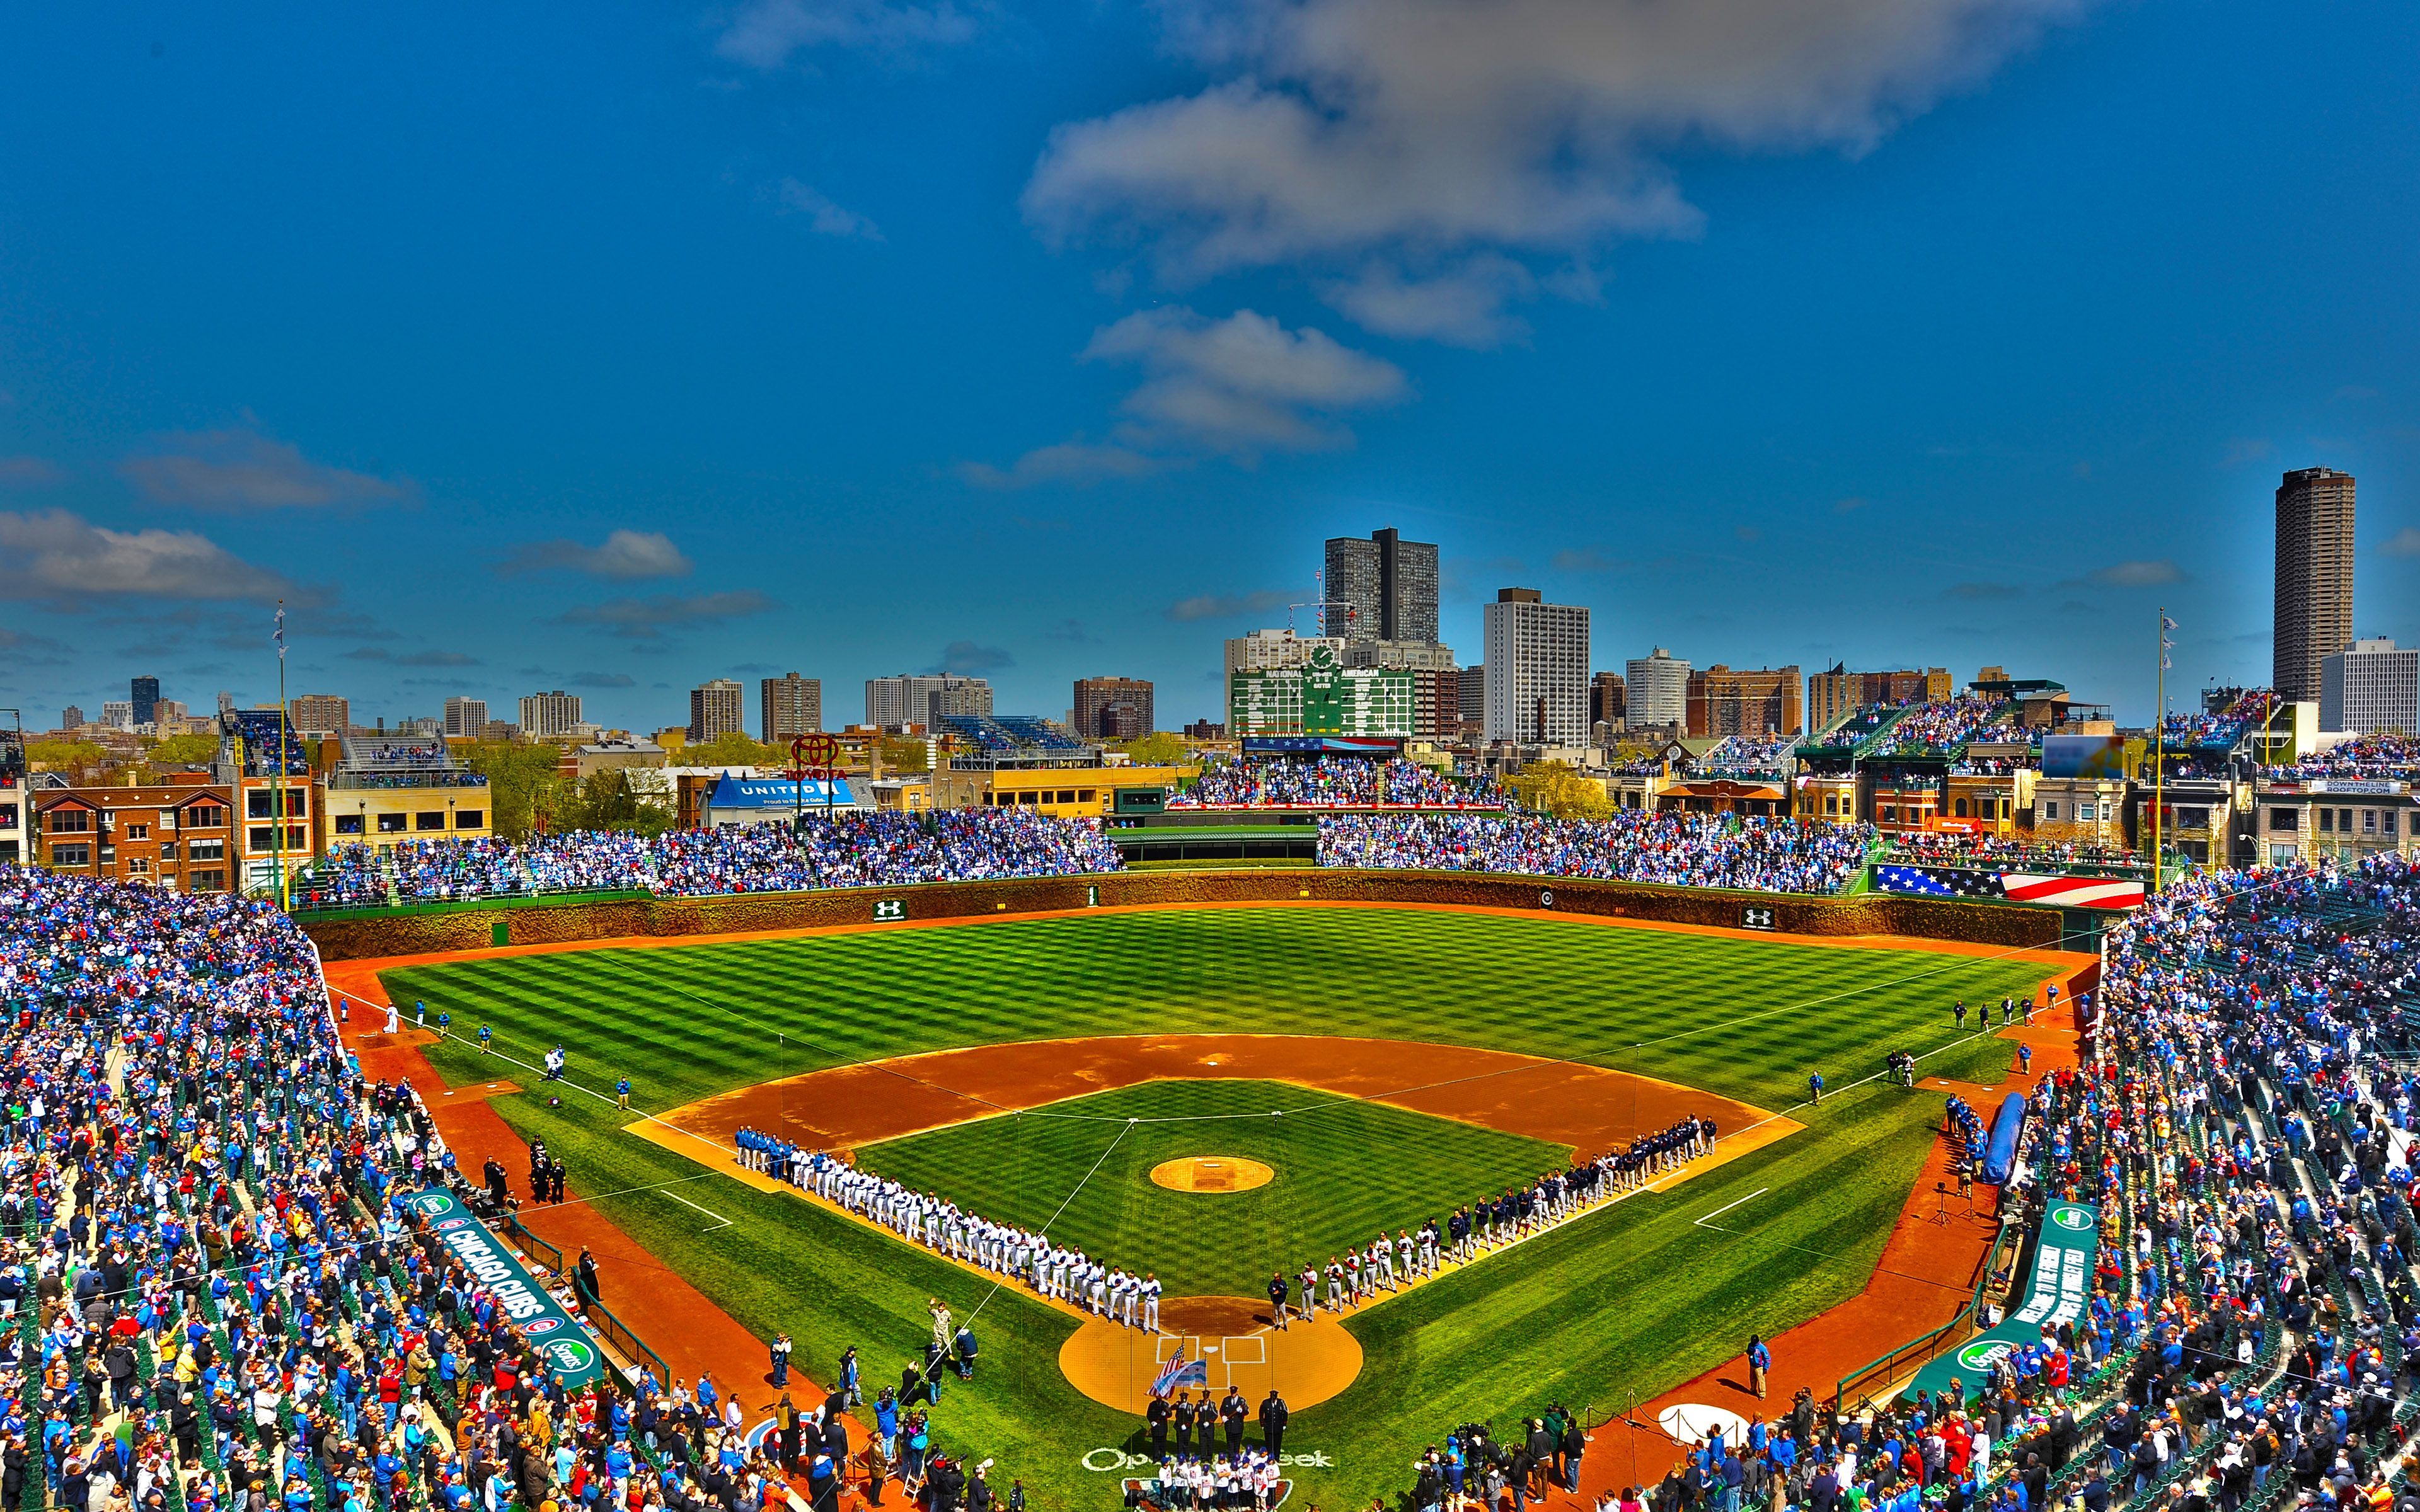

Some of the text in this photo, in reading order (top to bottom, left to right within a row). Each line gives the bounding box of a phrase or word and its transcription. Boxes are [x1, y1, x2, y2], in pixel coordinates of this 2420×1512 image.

[1265, 670, 1303, 678] NATIONAL
[1341, 669, 1380, 677] AMERICAN
[784, 769, 848, 782] TOYOTA
[740, 785, 815, 795] UNITED
[2064, 1248, 2085, 1267] FIELD
[446, 1230, 545, 1319] CHICAGO CUBS
[2014, 1292, 2056, 1324] WELCOME
[2036, 1282, 2057, 1294] TO
[2061, 1290, 2083, 1303] OF
